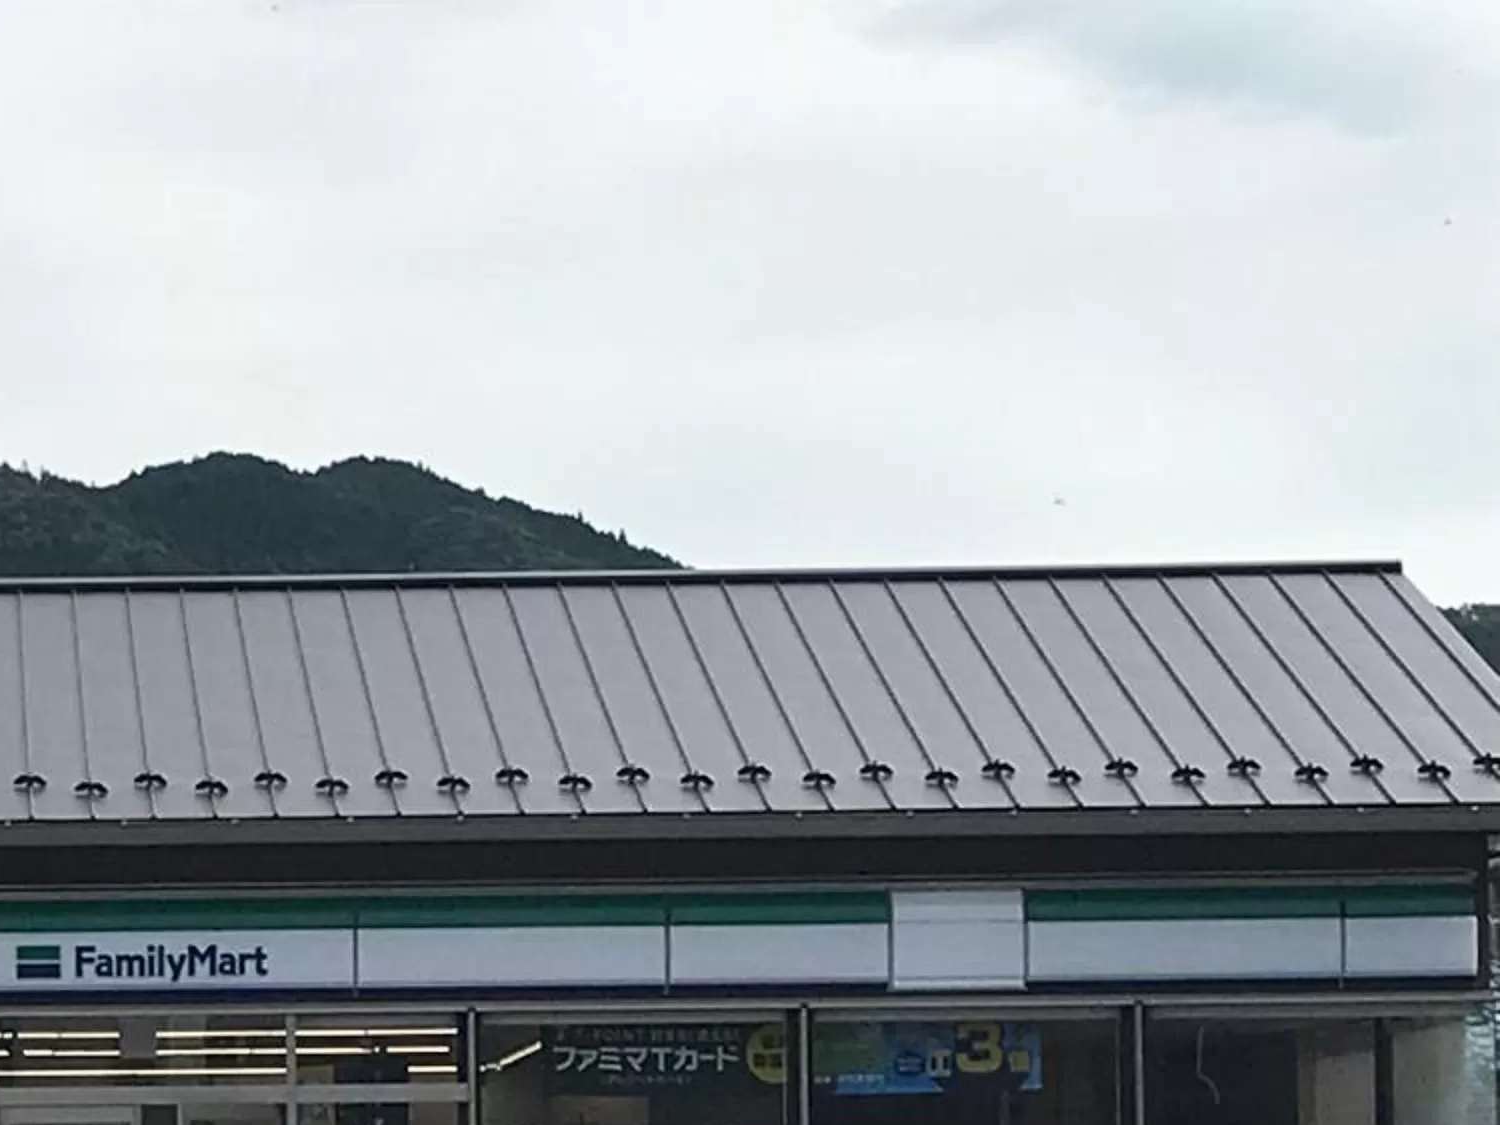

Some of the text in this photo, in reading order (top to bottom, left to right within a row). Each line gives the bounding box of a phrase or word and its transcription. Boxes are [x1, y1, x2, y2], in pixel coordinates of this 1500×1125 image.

[75, 944, 269, 982] FamilyMart
[552, 1046, 740, 1072] ファミマTカード
